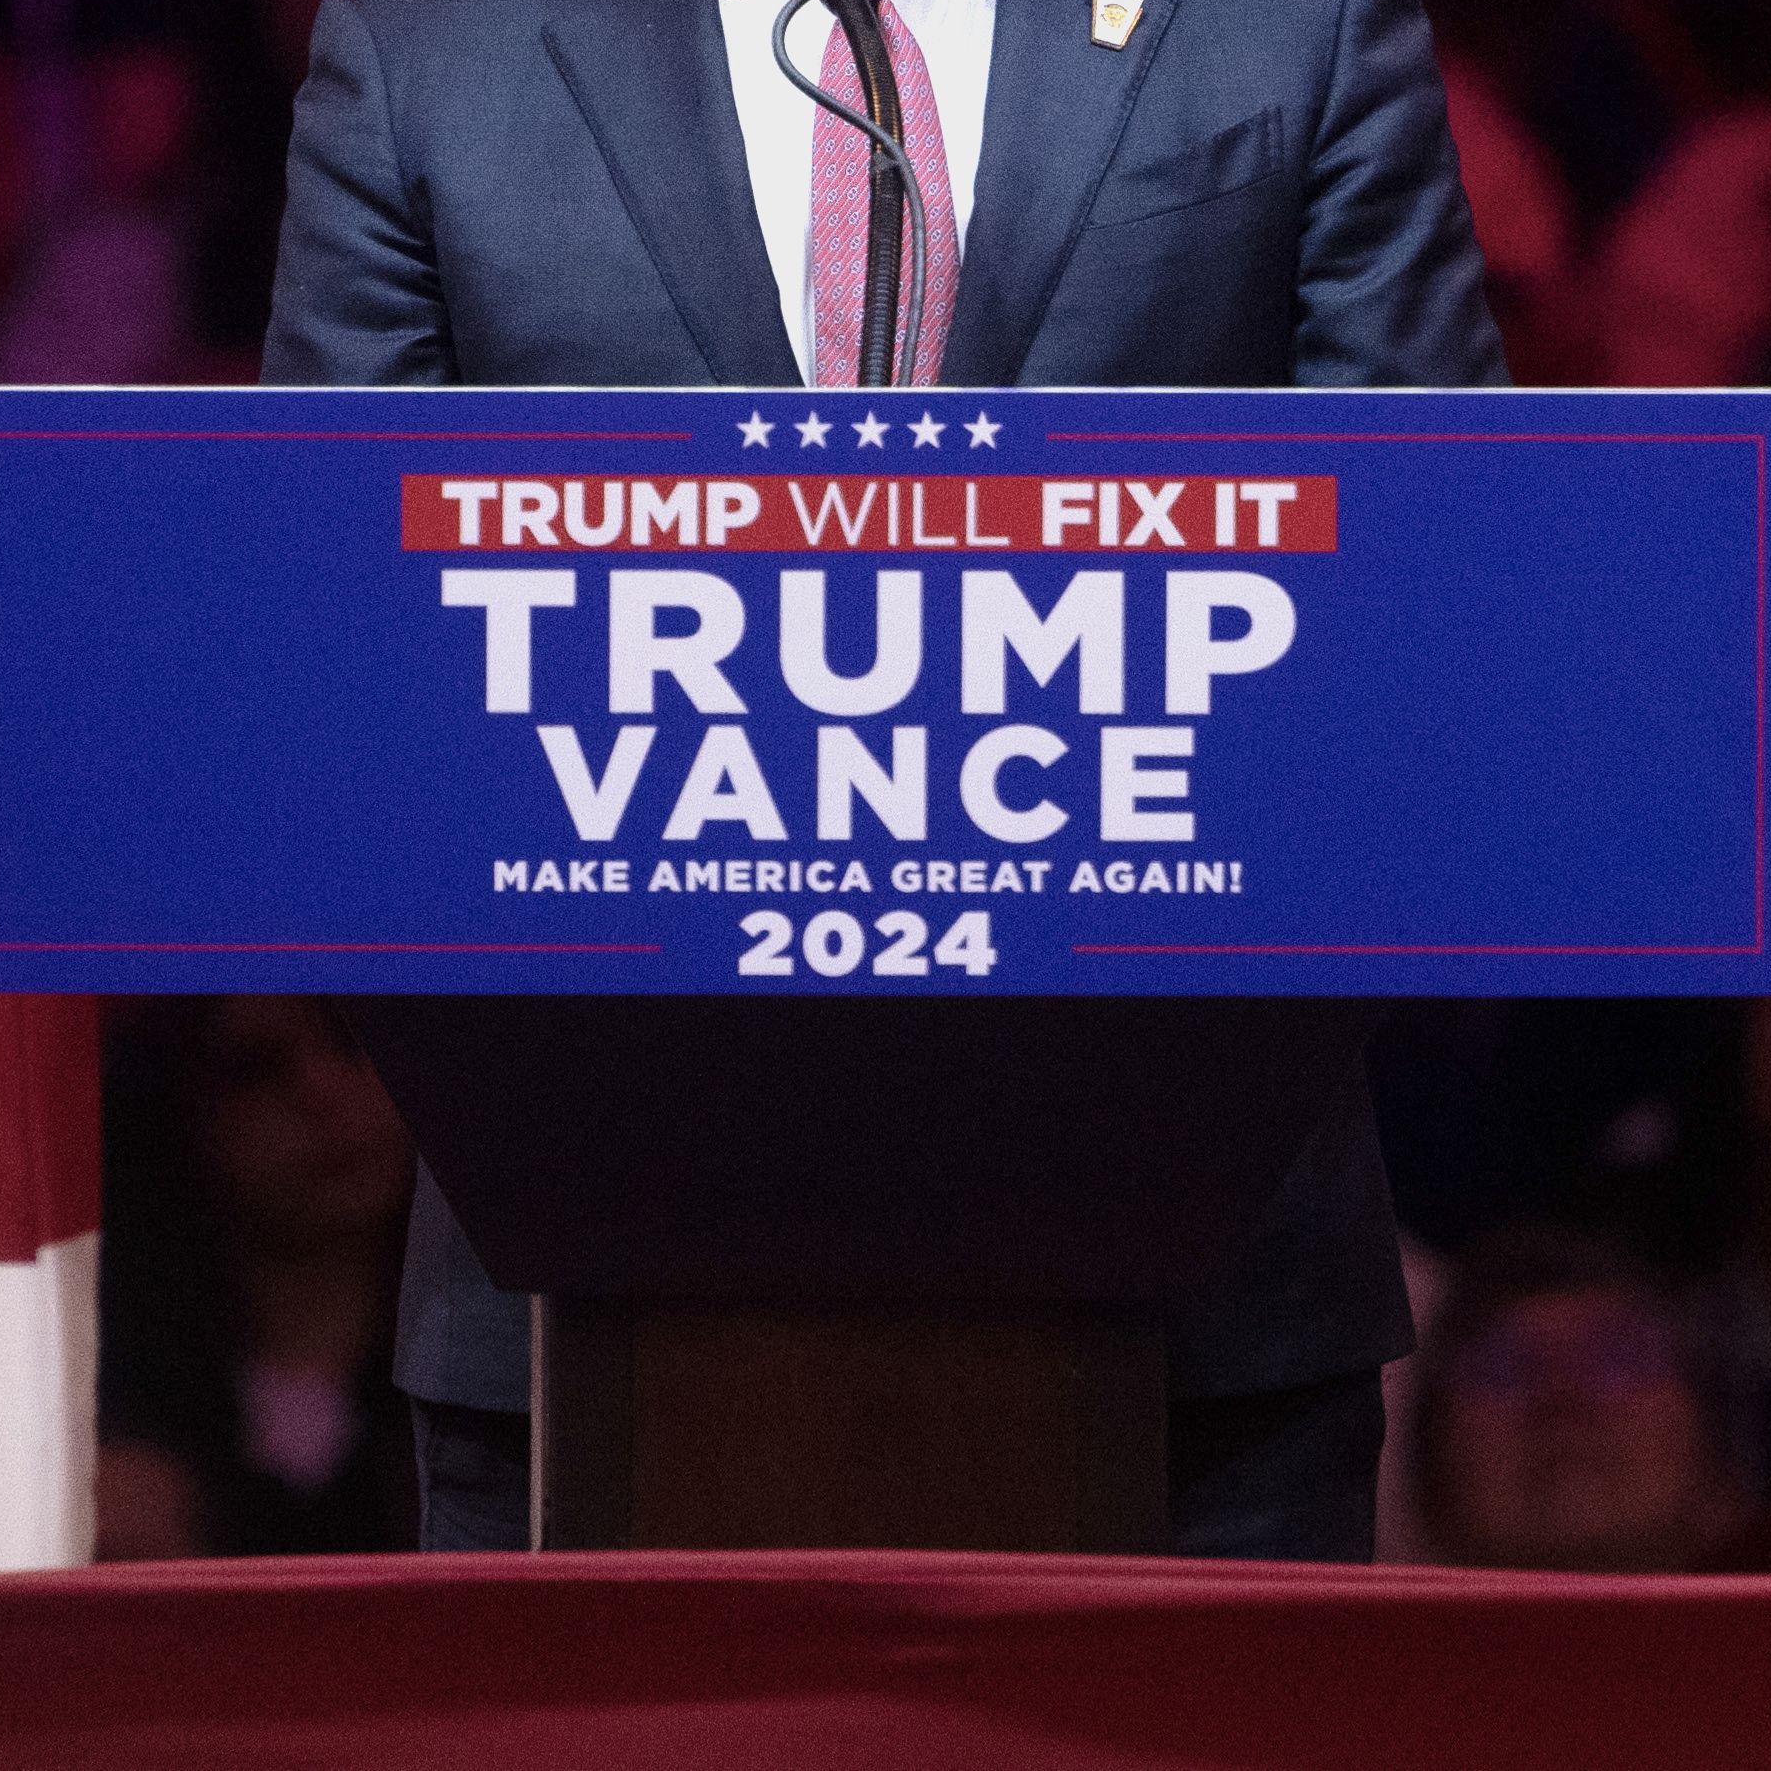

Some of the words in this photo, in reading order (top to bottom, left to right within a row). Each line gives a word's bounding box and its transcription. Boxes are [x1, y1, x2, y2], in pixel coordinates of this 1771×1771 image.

[441, 480, 762, 547] TRUMP
[787, 481, 1011, 547] WILL
[1041, 481, 1187, 547] FIX
[1214, 481, 1298, 547] IT
[440, 568, 1297, 717] TRUMP
[536, 723, 1195, 844] VANCE
[493, 860, 630, 893] MAKE
[648, 860, 872, 893] AMERICA
[890, 860, 1052, 893] GREAT
[1069, 860, 1242, 894] AGAIN!
[738, 909, 997, 977] 2024
